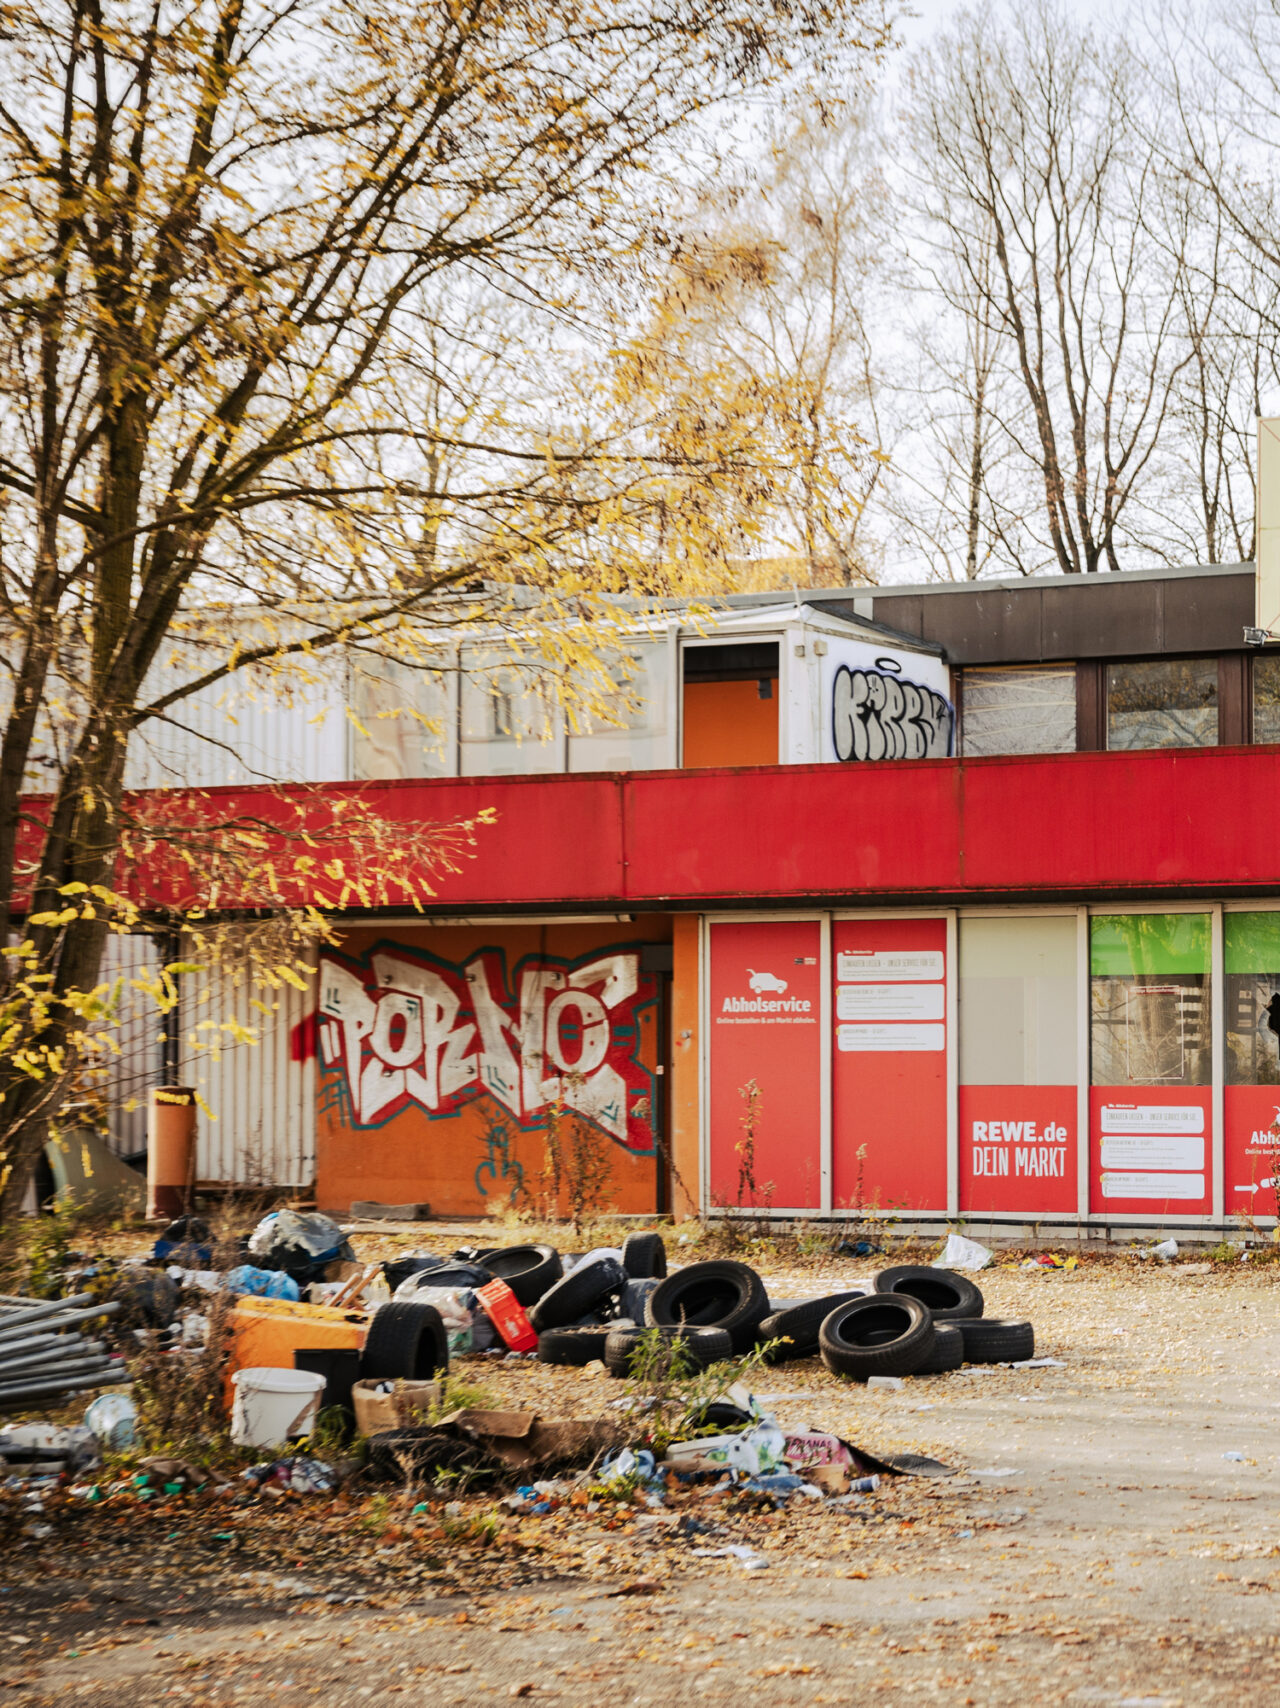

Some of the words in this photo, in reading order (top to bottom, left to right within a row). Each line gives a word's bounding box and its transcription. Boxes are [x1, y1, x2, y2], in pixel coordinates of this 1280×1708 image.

[722, 996, 811, 1013] Abholservice
[973, 1121, 1068, 1142] REWE.de
[973, 1146, 1009, 1177] DEIN
[1015, 1146, 1067, 1178] MARKT
